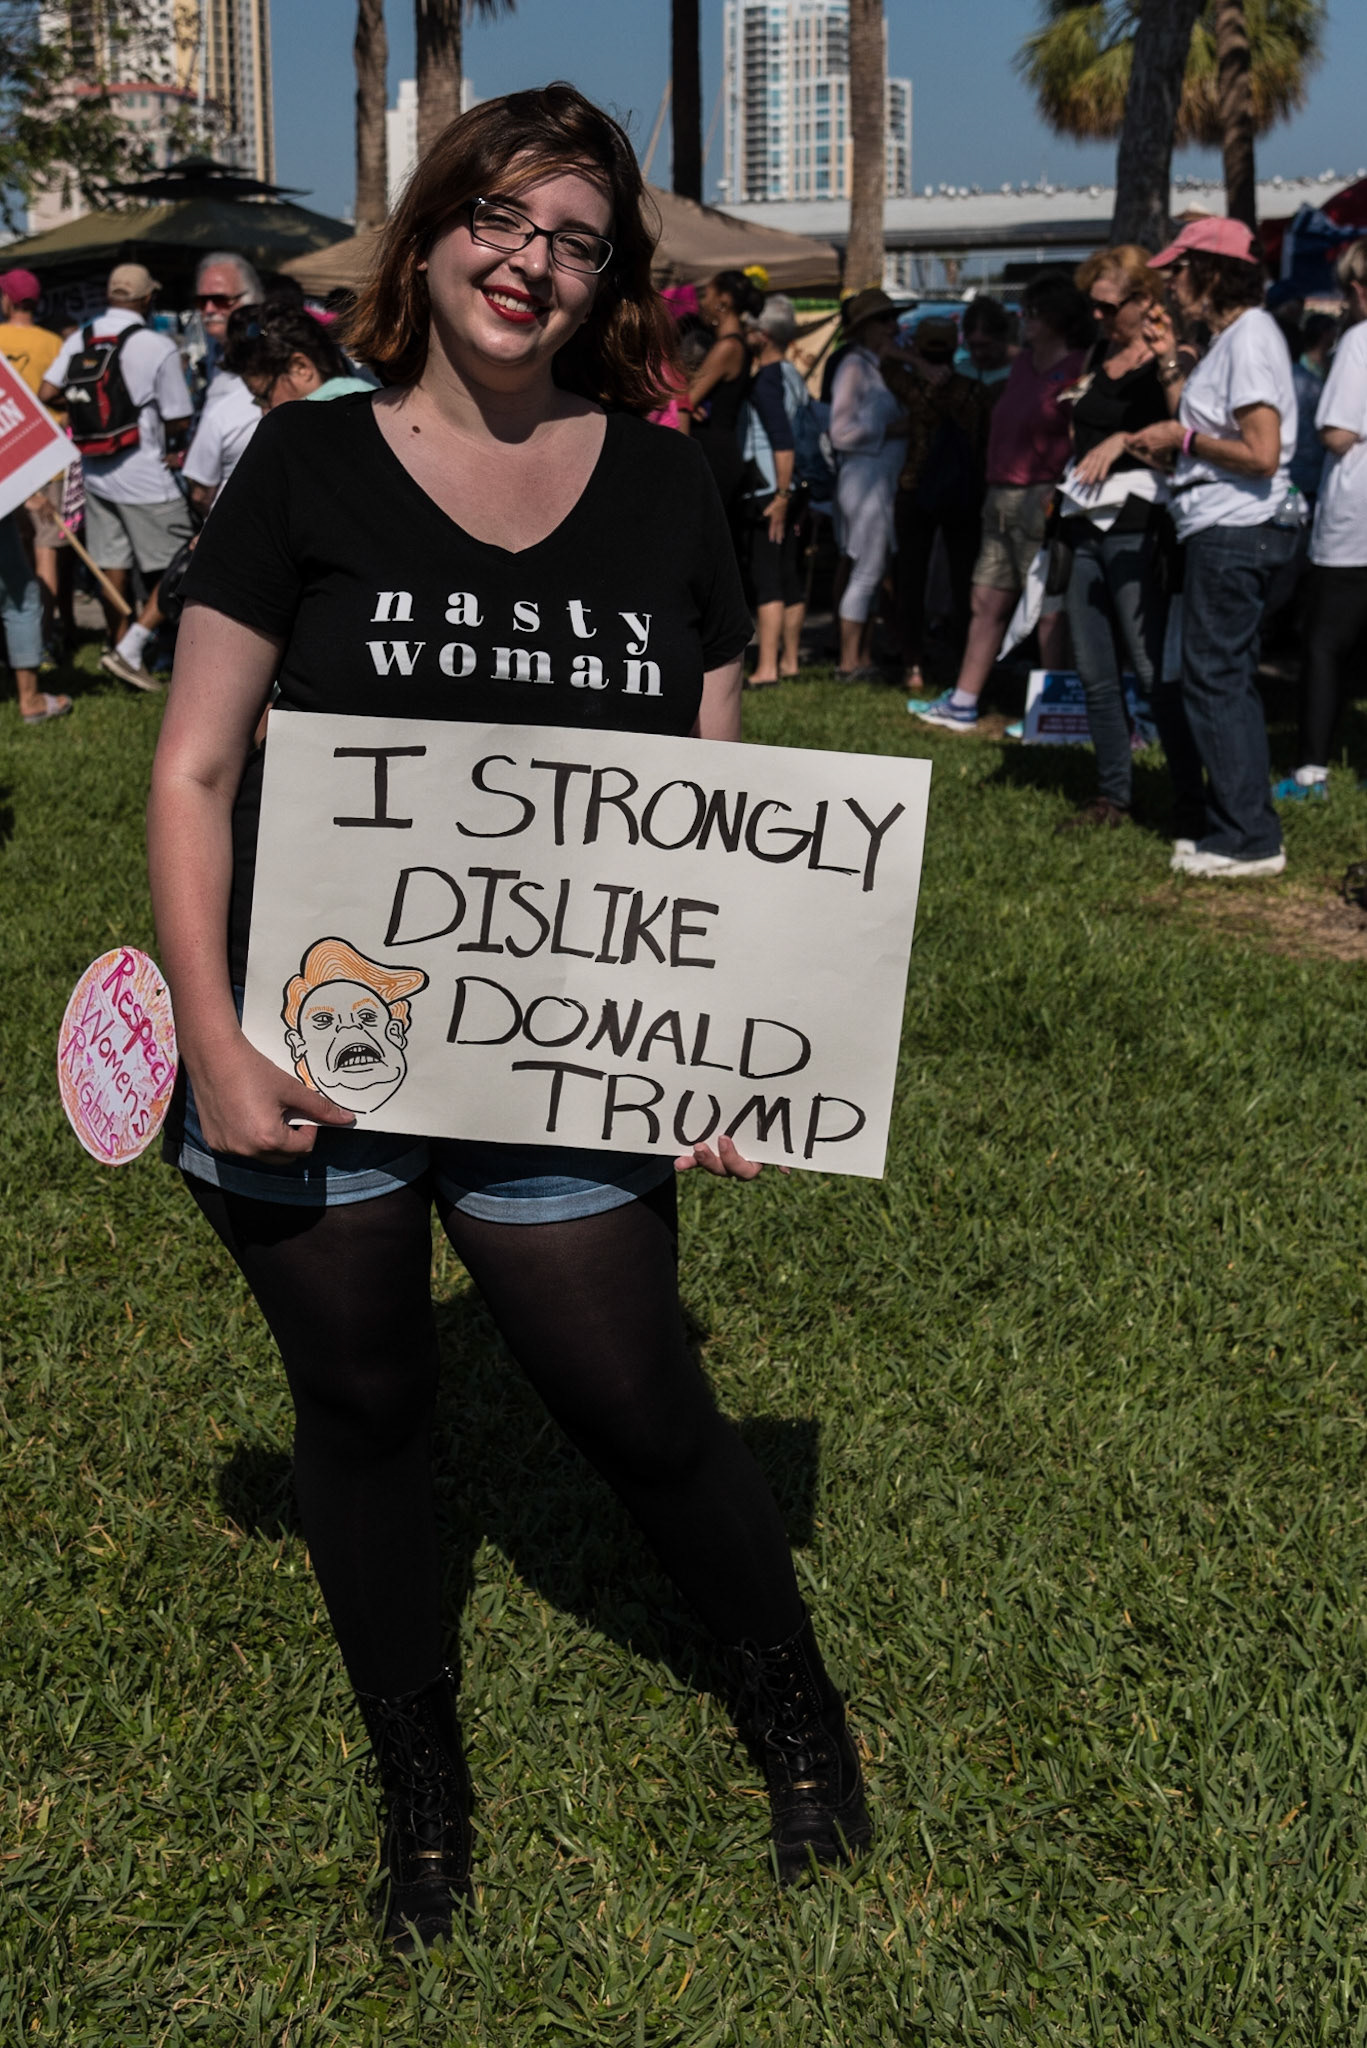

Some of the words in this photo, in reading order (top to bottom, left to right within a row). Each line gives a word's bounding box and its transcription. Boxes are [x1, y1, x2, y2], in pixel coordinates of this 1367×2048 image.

[365, 641, 664, 697] woman
[370, 591, 653, 656] nasty
[333, 746, 426, 829] I
[456, 755, 905, 893] STRONGLY
[384, 867, 720, 969] DISLIKE
[447, 976, 811, 1079] DONALD
[512, 1061, 866, 1159] TRUMP
